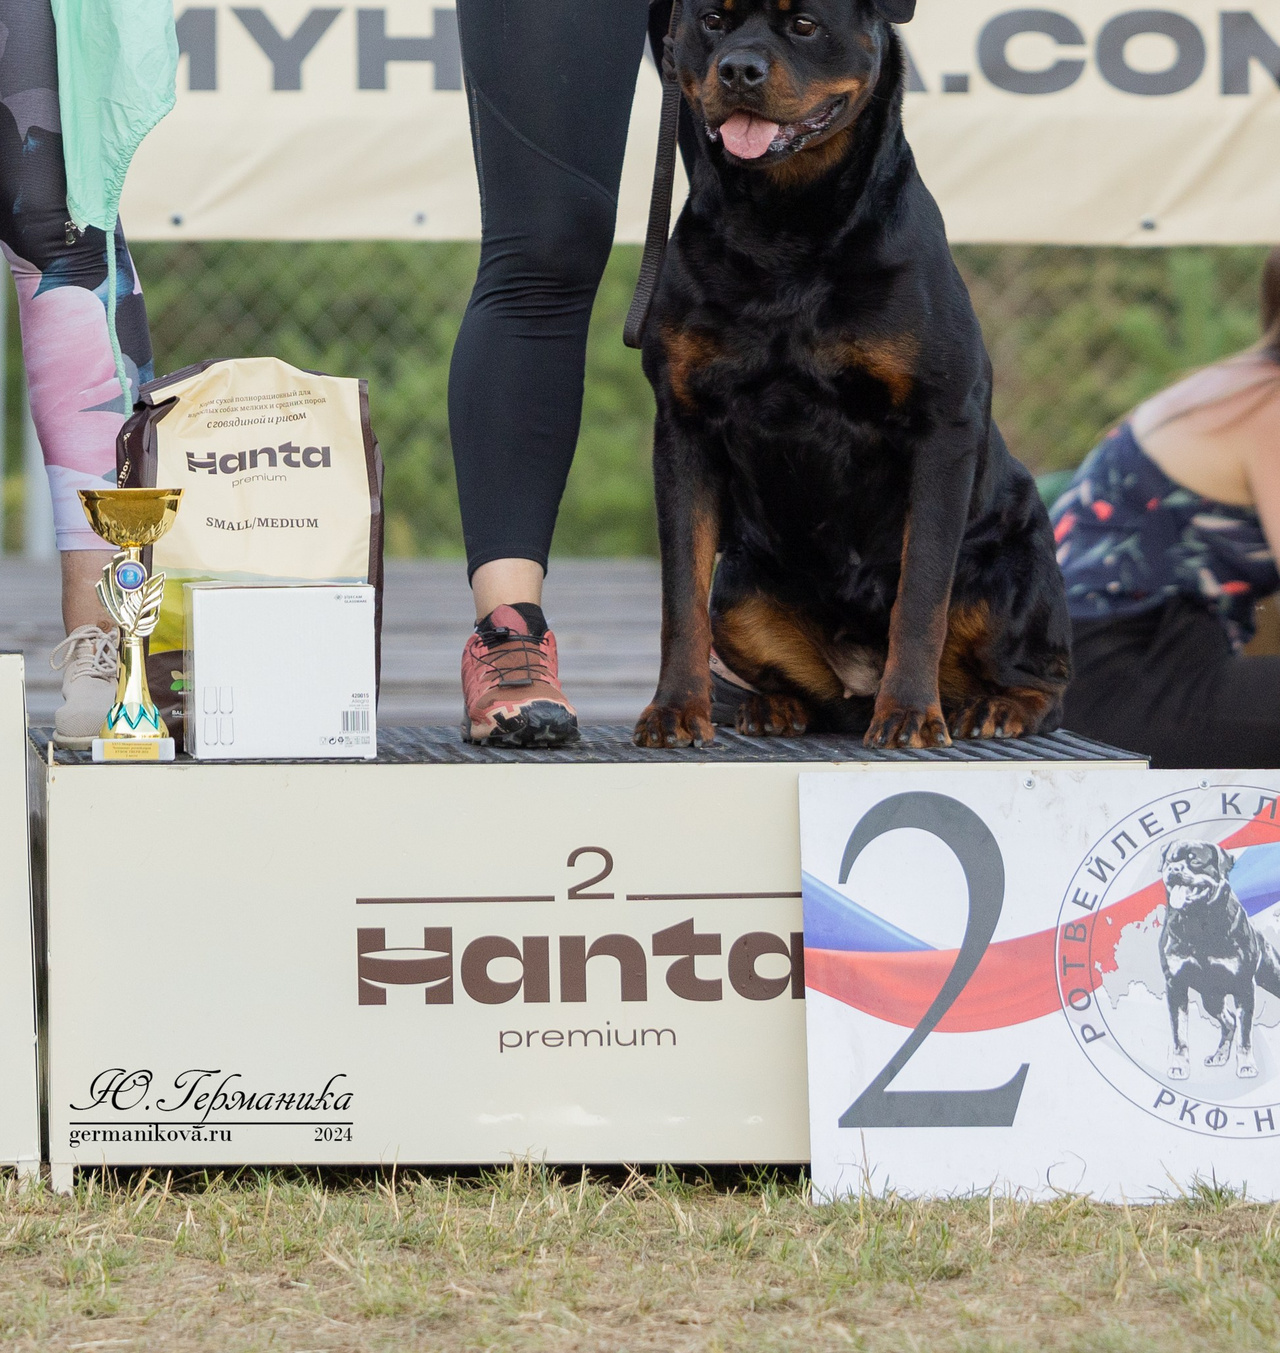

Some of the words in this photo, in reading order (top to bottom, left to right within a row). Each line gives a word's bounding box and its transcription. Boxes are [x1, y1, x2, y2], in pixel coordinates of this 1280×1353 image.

[216, 396, 235, 406] сухой
[235, 389, 297, 403] полнорационный
[219, 404, 239, 414] собак
[275, 400, 304, 410] средних
[304, 397, 327, 406] пород
[206, 421, 212, 429] с
[212, 415, 267, 428] говядиной
[267, 415, 274, 424] и
[275, 411, 307, 424] рисом
[185, 440, 332, 476] Hanta
[231, 473, 287, 489] premium
[205, 516, 320, 532] SMALL/MEDIUM
[566, 846, 615, 900] 2
[1061, 798, 1191, 1045] РОТВЕЙЛЕР
[356, 916, 805, 1006] Hanta
[837, 790, 1031, 1129] 2
[498, 1021, 677, 1054] premium
